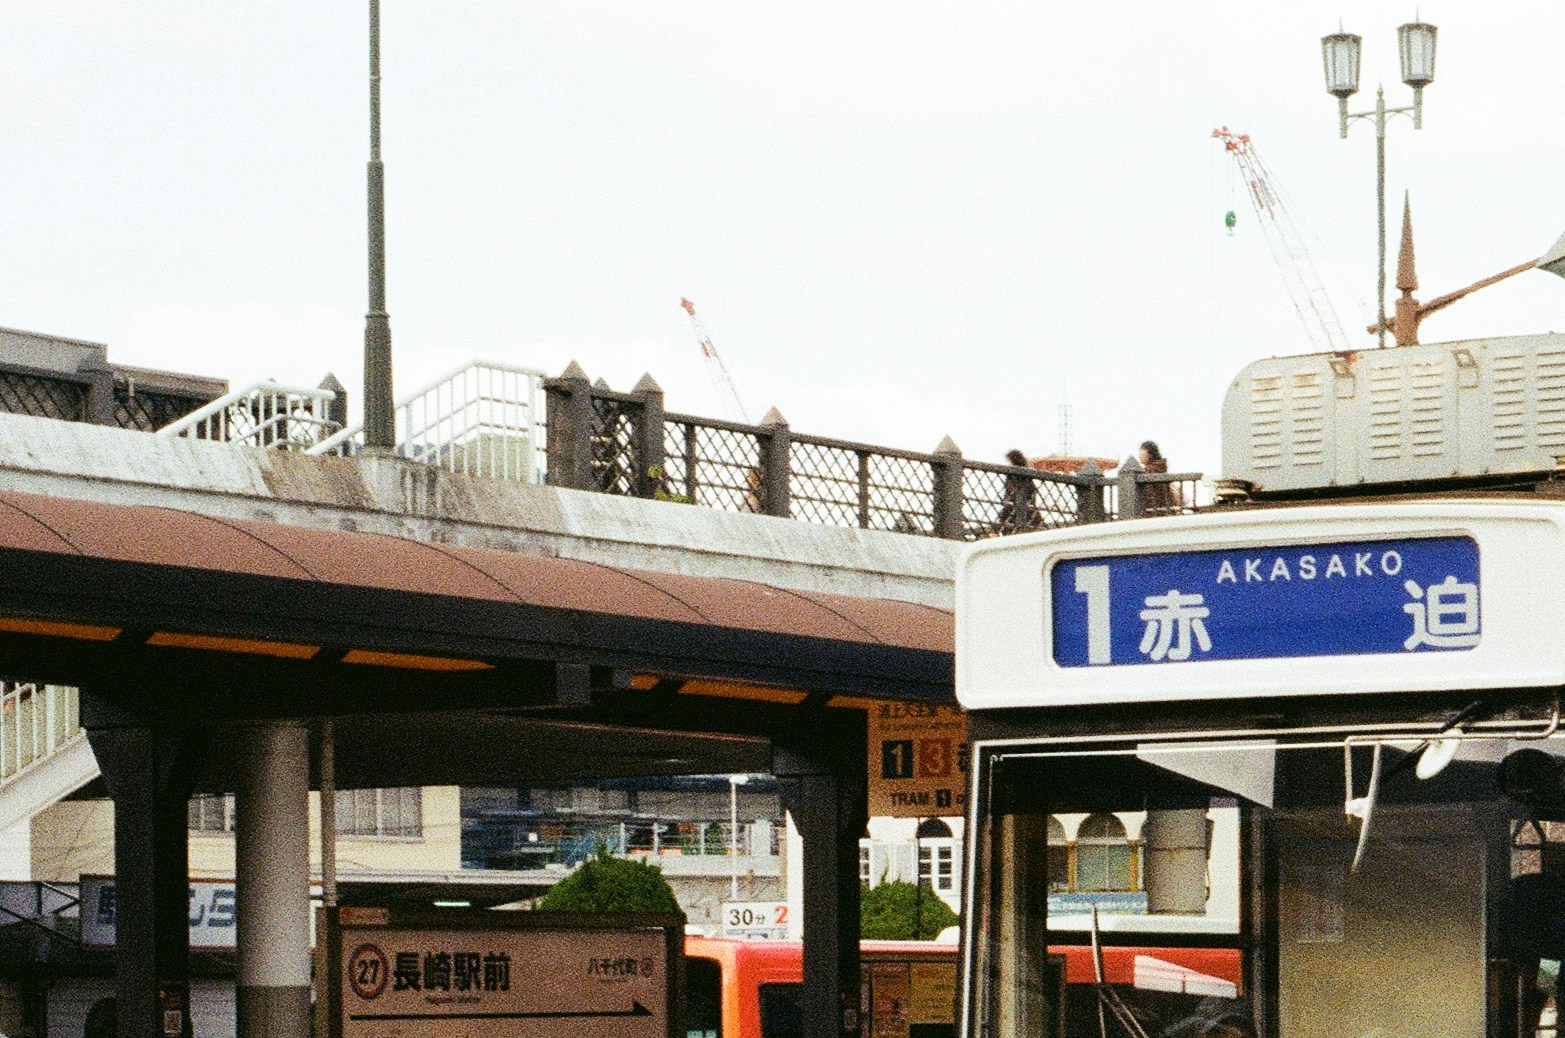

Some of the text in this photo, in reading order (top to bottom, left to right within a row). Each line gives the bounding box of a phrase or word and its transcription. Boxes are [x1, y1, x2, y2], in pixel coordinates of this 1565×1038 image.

[1216, 550, 1403, 584] AKASAKO
[1074, 565, 1482, 664] 1 赤 迫
[890, 792, 929, 806] TRAM
[357, 951, 512, 992] 27 長崎駅前
